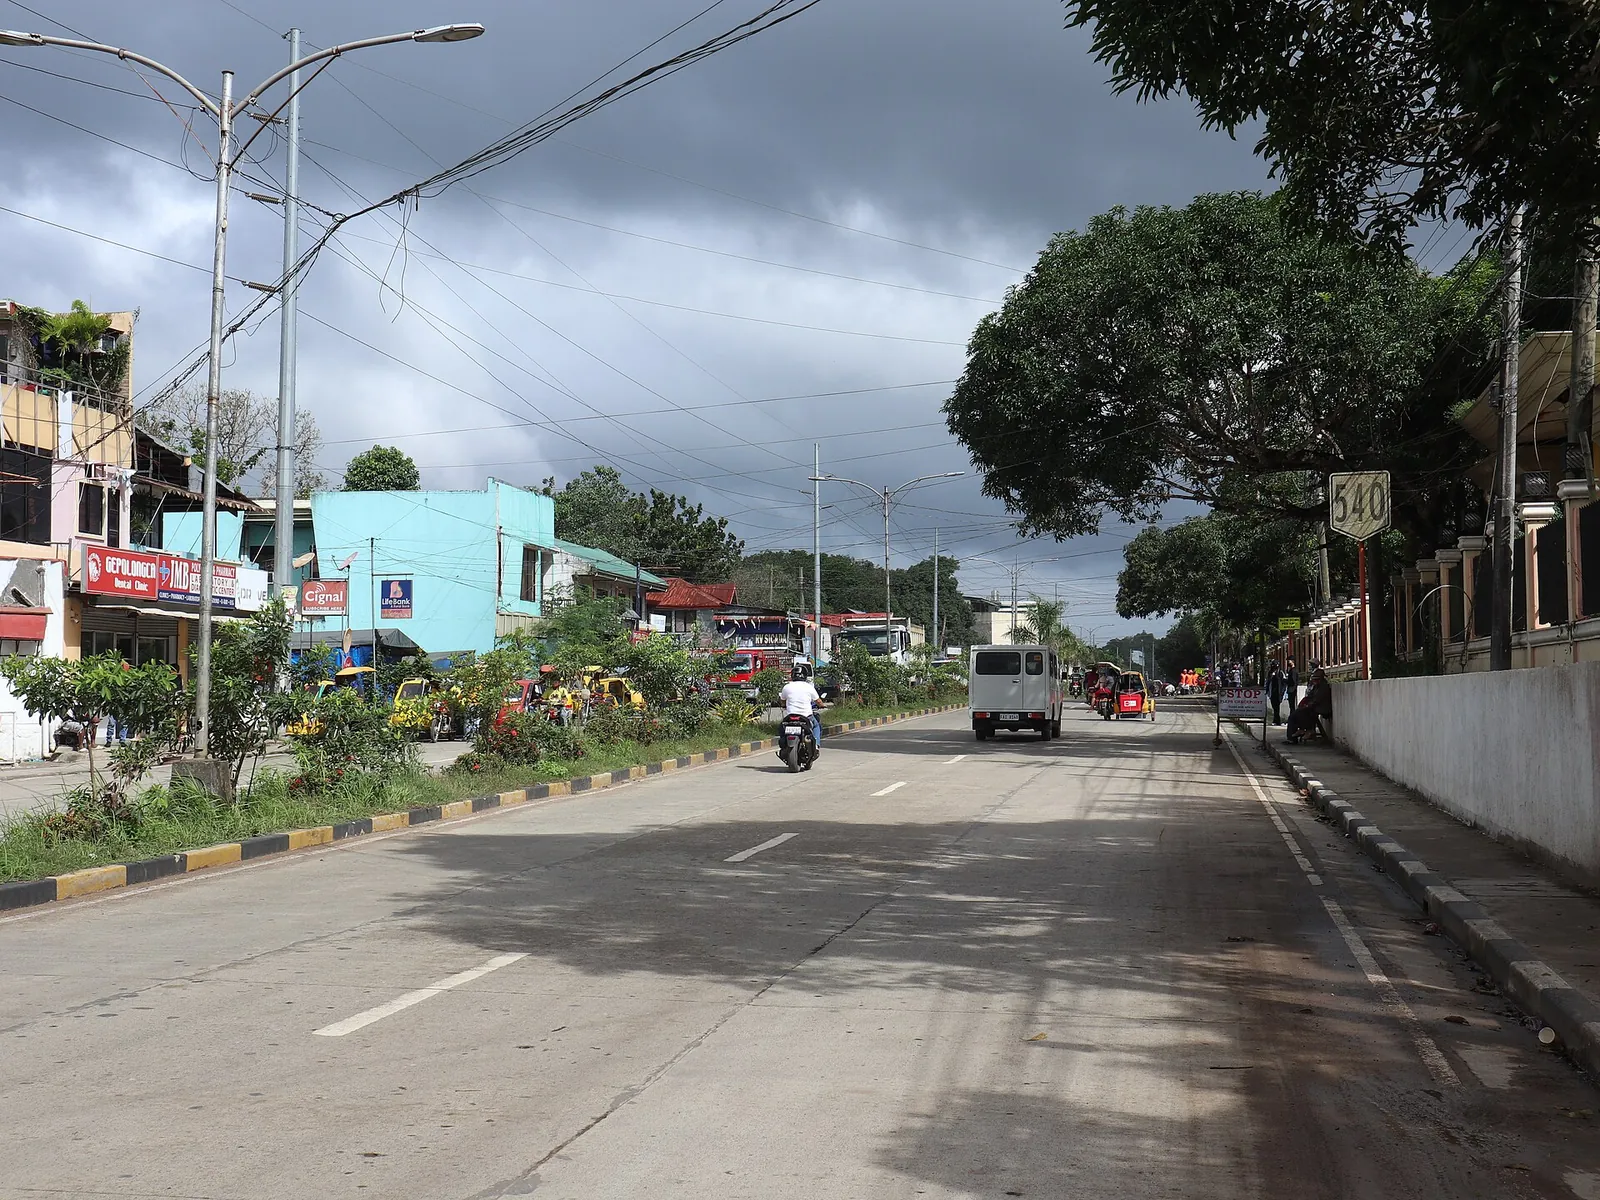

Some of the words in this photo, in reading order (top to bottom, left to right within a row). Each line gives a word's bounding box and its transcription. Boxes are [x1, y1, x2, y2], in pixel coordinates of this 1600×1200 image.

[1334, 482, 1385, 522] 540
[169, 560, 189, 590] JMB
[114, 577, 132, 589] Dental
[134, 580, 149, 591] Clinic
[219, 586, 236, 596] CENTER
[305, 590, 343, 605] Cignal
[755, 633, 764, 644] RV
[1226, 690, 1261, 699] STOP
